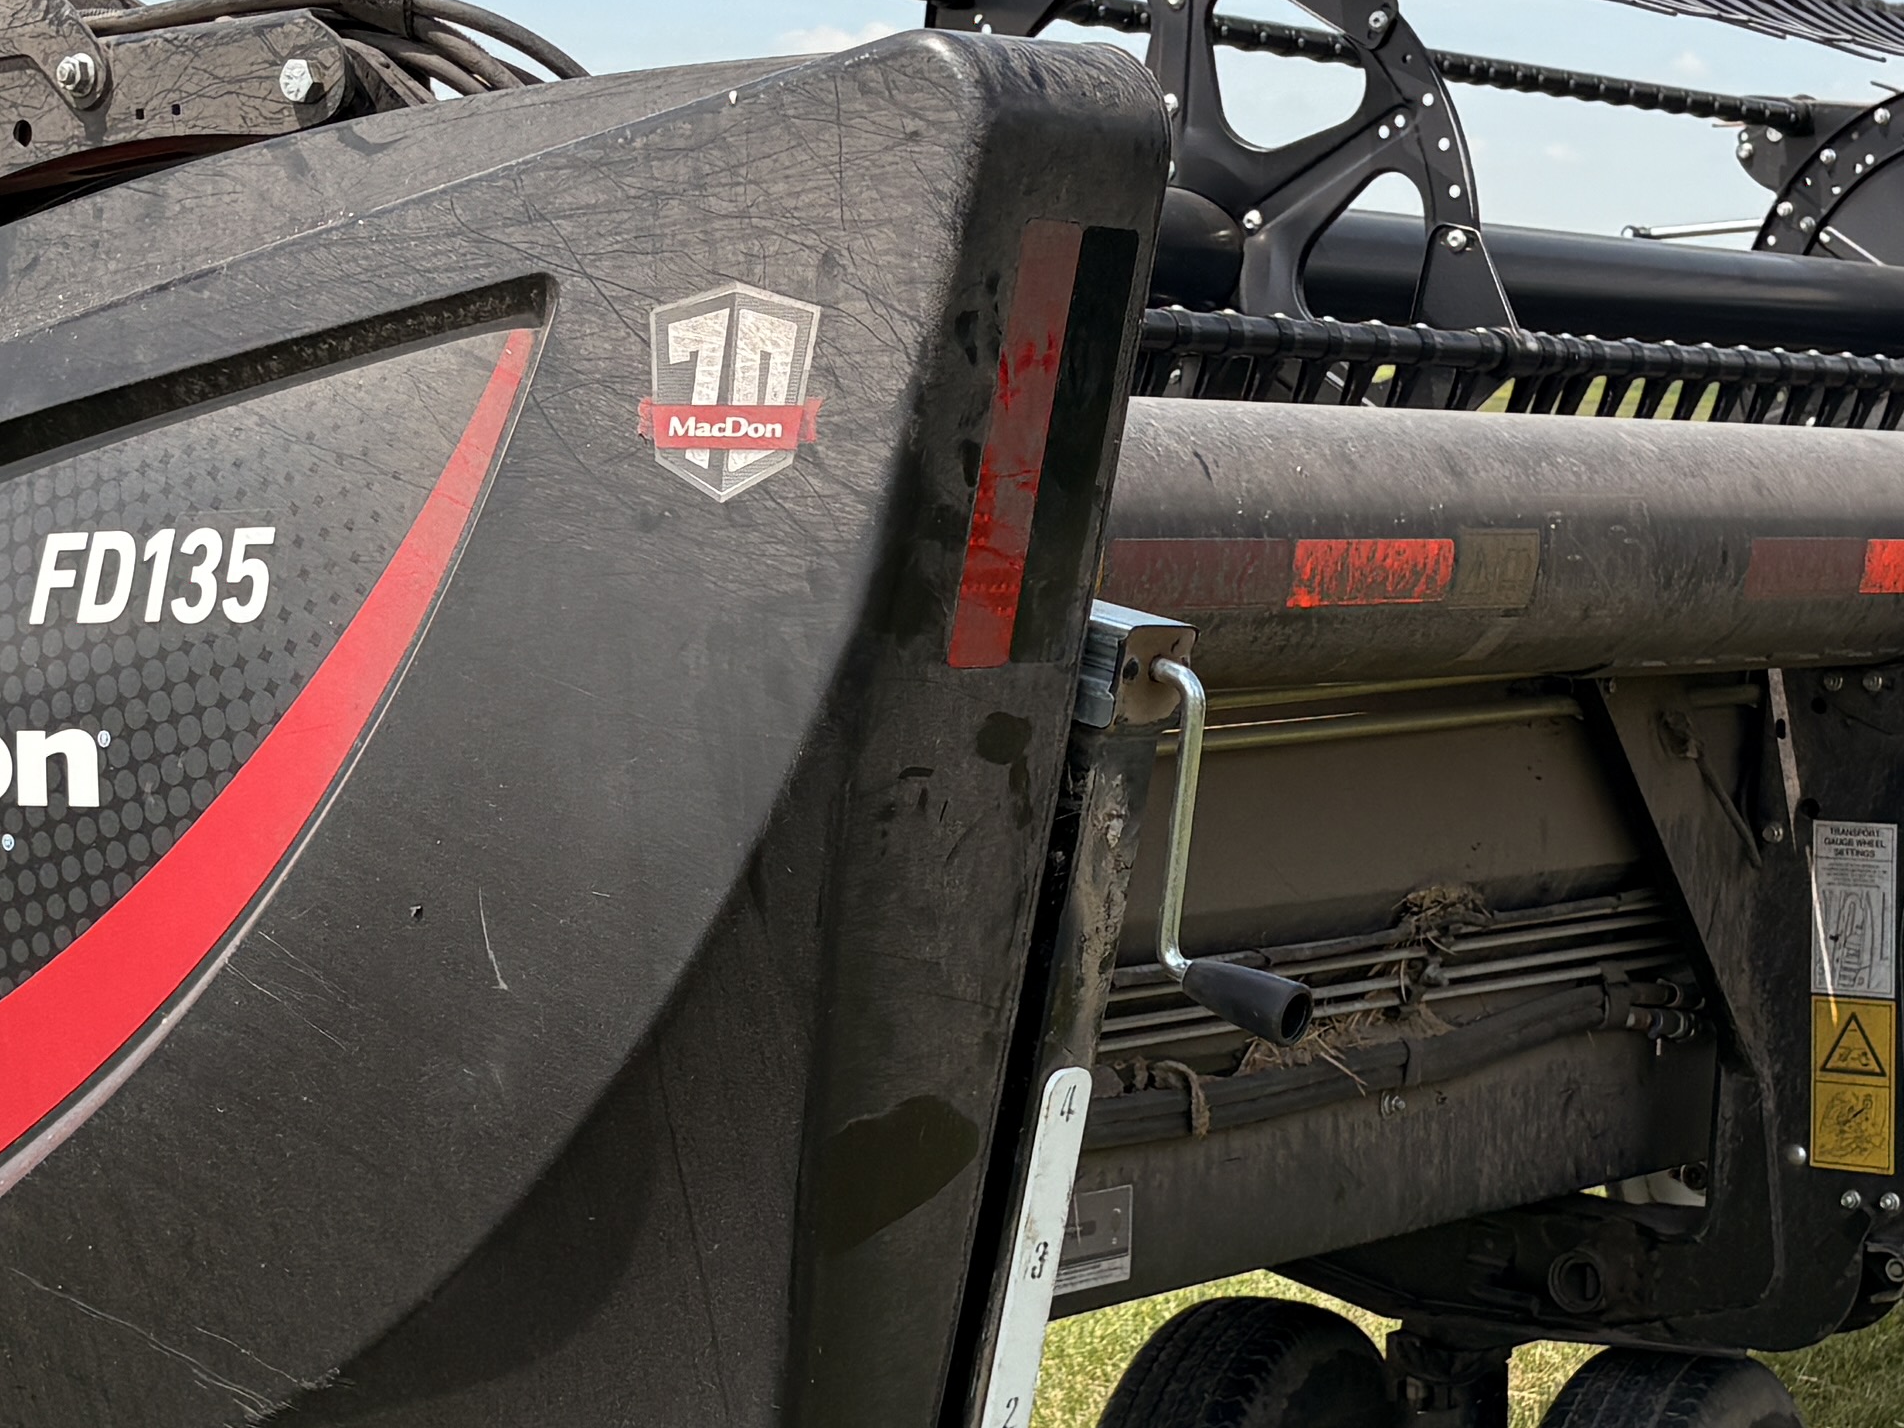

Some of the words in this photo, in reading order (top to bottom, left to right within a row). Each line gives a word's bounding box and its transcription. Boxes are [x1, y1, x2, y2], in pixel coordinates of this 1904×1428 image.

[668, 416, 782, 438] MacDon
[29, 526, 276, 624] FD135
[1060, 1084, 1076, 1123] 4
[1031, 1241, 1049, 1280] 3
